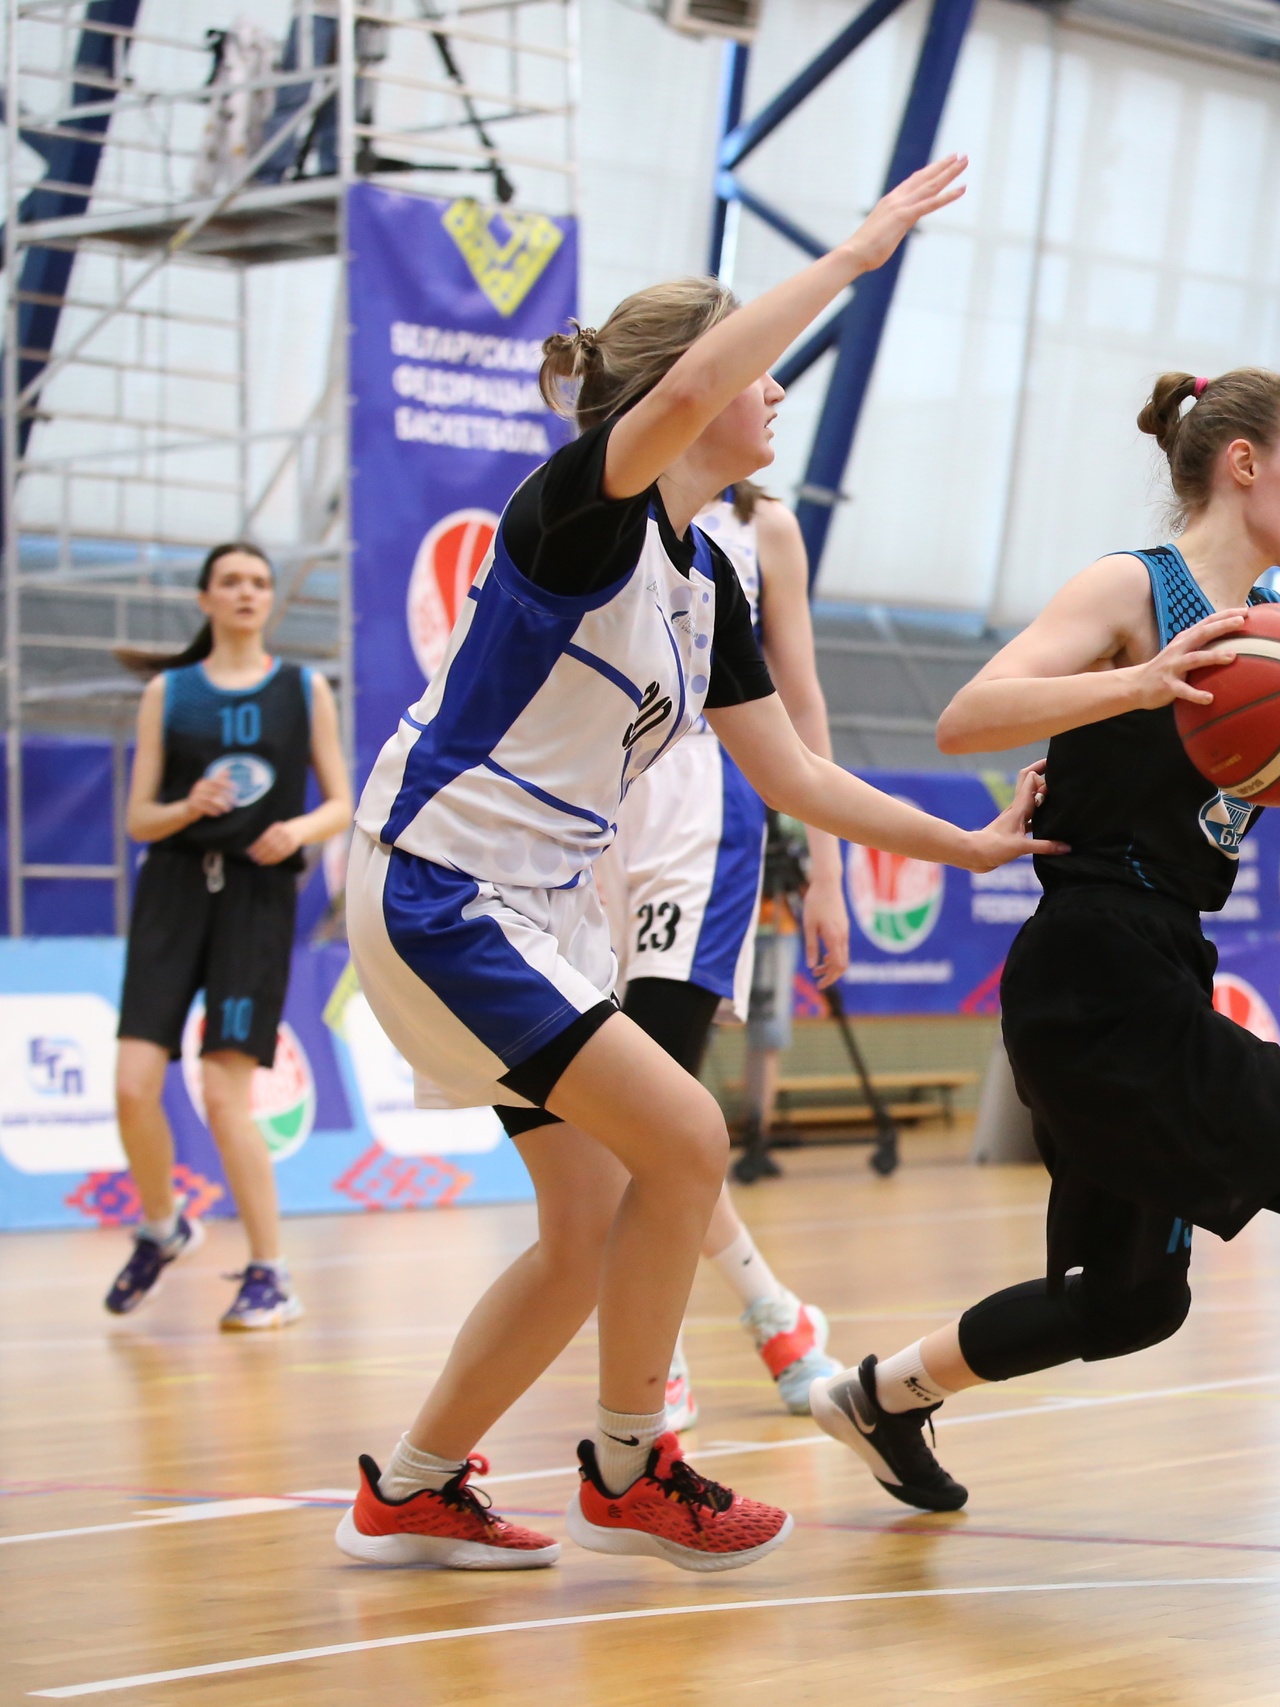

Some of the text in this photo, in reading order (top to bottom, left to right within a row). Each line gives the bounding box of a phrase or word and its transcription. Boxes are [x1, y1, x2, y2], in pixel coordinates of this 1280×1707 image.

[219, 702, 262, 747] 10
[636, 902, 681, 952] 23
[221, 997, 253, 1040] 10
